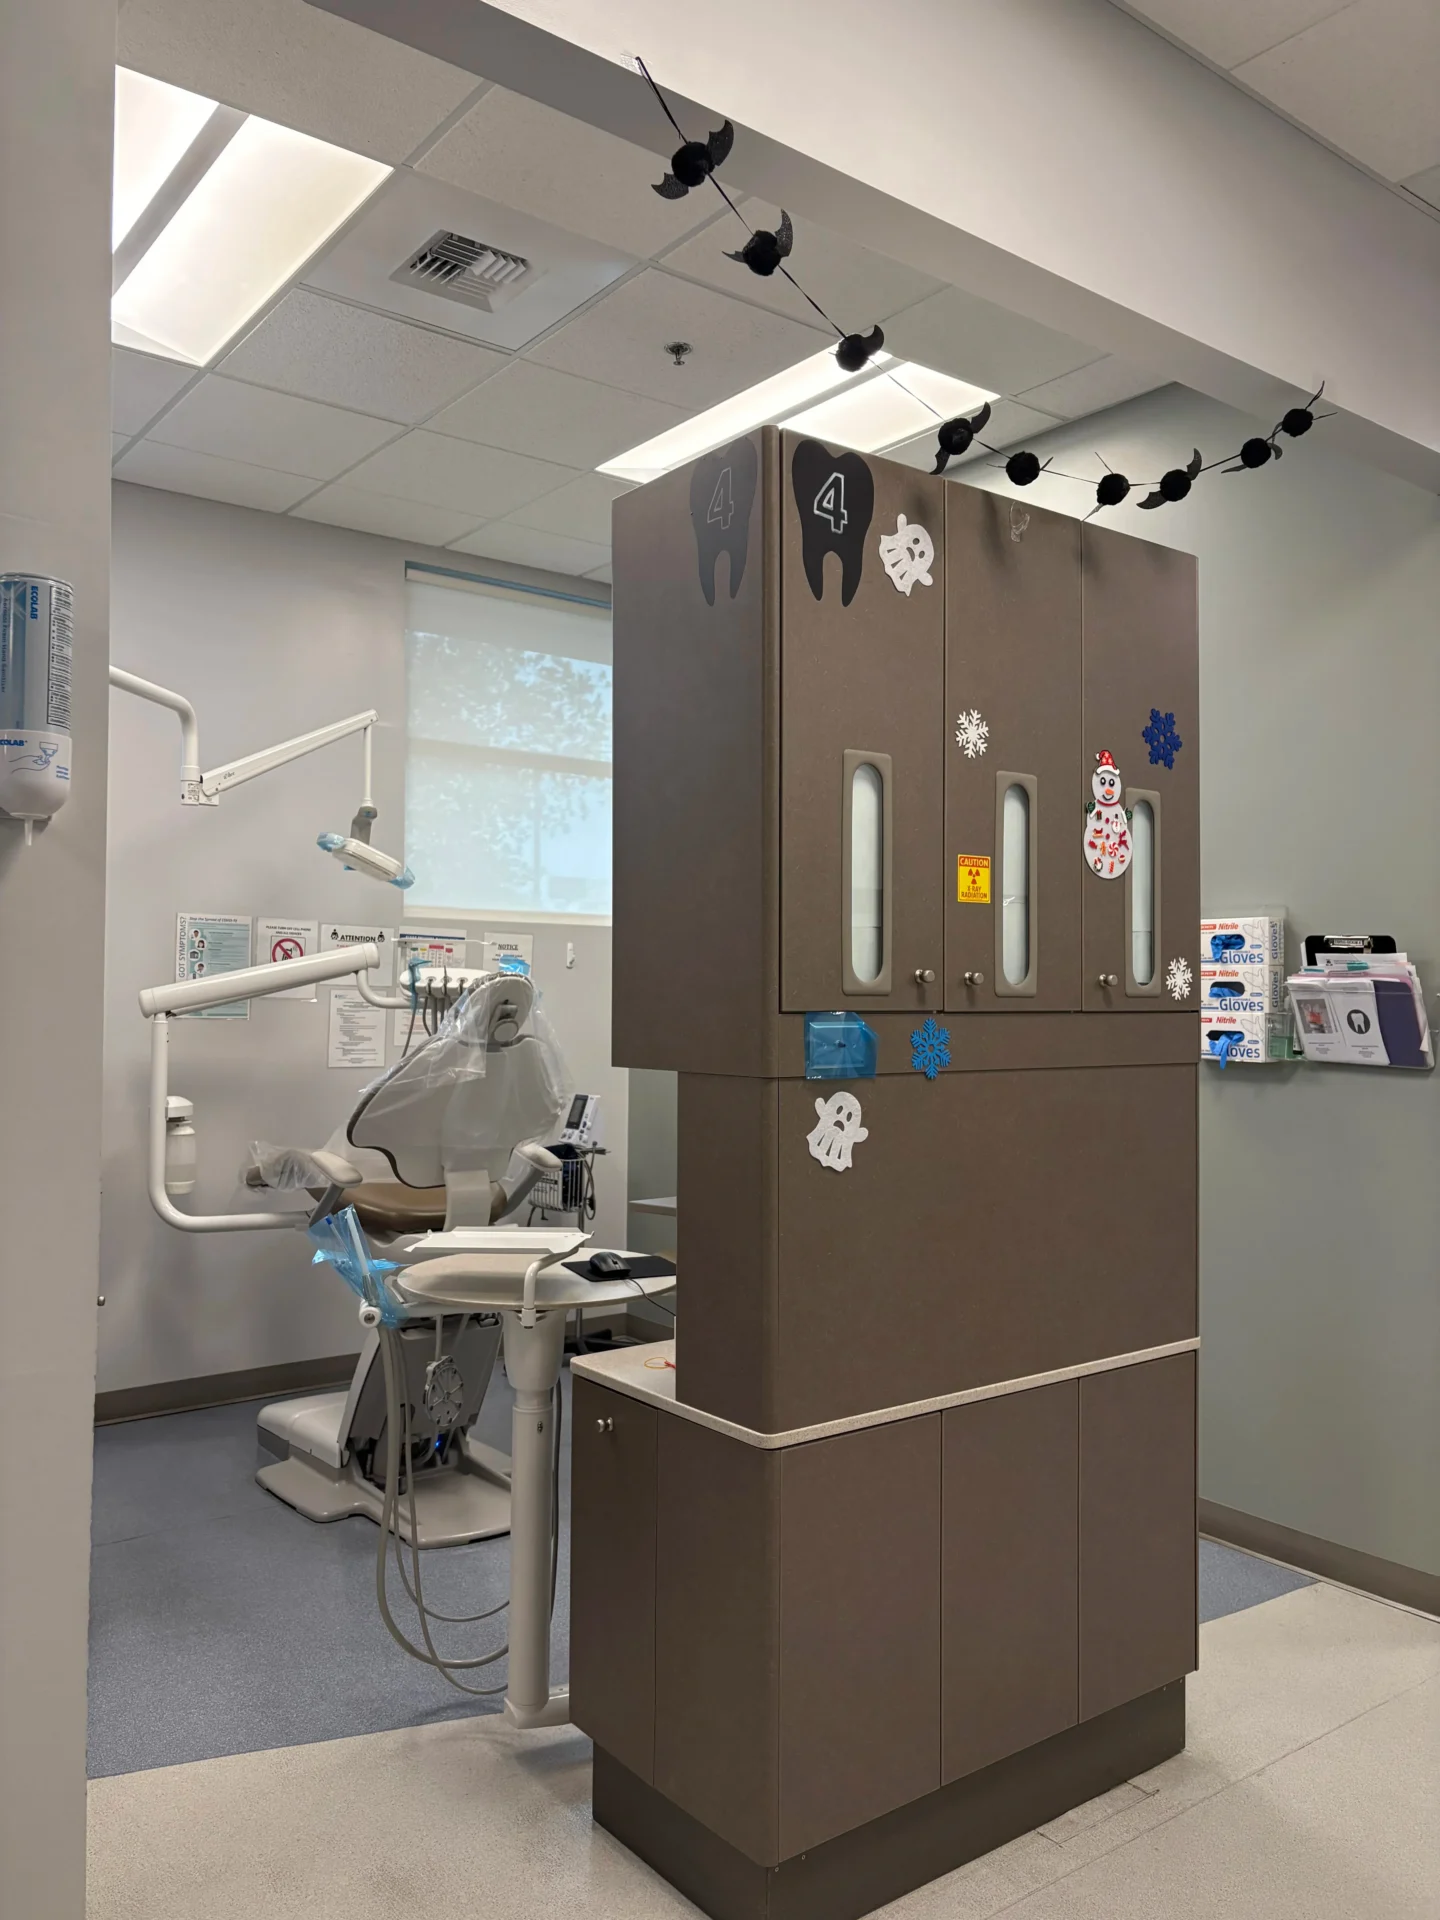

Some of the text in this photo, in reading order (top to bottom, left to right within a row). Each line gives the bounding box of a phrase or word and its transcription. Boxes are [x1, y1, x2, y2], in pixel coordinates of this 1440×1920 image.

[707, 467, 734, 530] 4
[813, 472, 848, 534] 4
[30, 585, 39, 620] ECOLAB
[0, 739, 25, 747] COLAB
[960, 857, 989, 867] CAUTION
[1217, 922, 1239, 931] Nitrile
[340, 934, 376, 942] ATTENTION
[178, 916, 187, 978] GOT SYMPTOMS?
[497, 943, 518, 951] NOTICE
[1220, 950, 1264, 964] Gloves
[1218, 970, 1239, 978] Nitrile
[1271, 971, 1279, 1008] Gloves
[1219, 998, 1264, 1012] Gloves
[1215, 1016, 1237, 1024] Nitrile
[1226, 1043, 1260, 1058] loves
